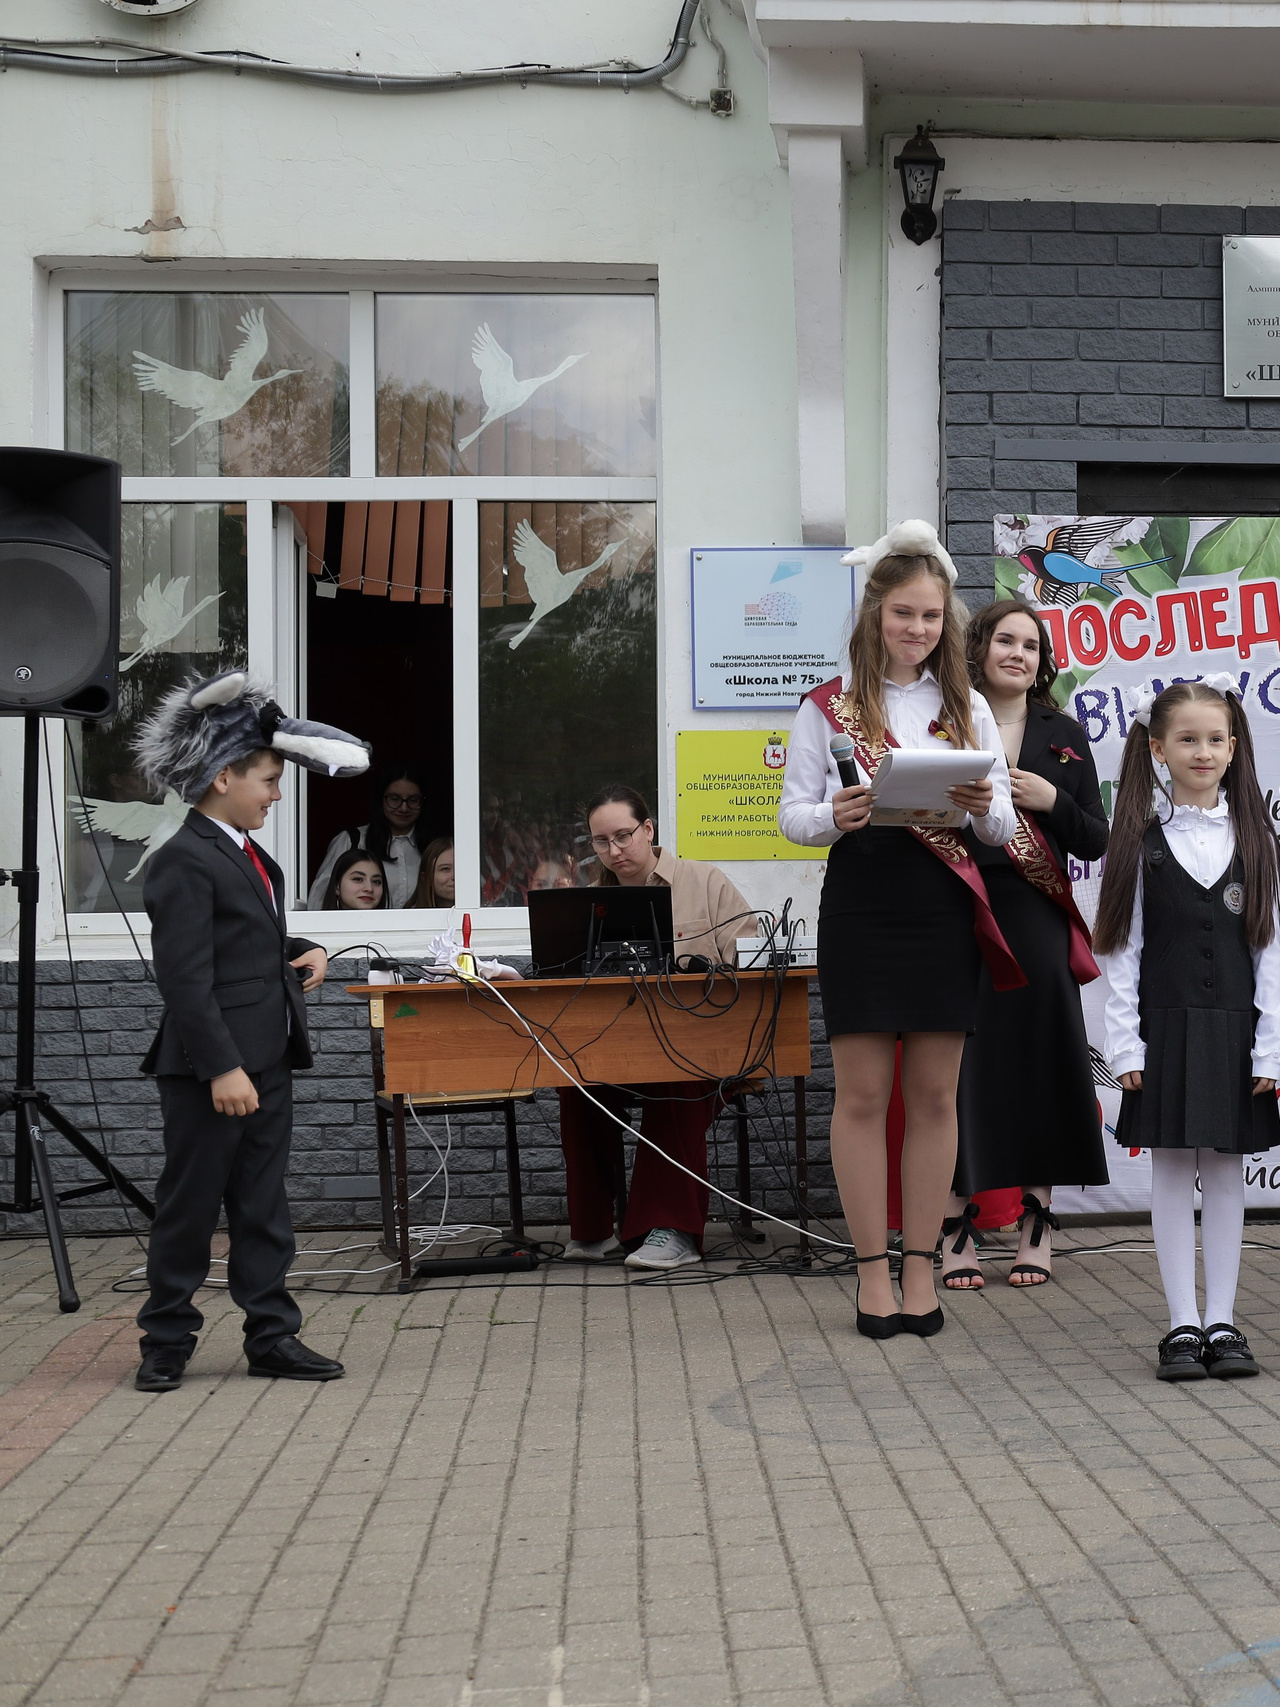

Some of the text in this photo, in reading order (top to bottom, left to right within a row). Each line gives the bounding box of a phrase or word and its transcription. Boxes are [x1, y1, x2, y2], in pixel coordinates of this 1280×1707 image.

[725, 674, 823, 685] «Школа № 75»
[703, 774, 785, 782] МУНИЦИПАЛЬНО
[686, 783, 784, 791] ОБЩЕОБРАЗОВАТЕЛЬ
[696, 829, 733, 837] НИЖНИЙ
[735, 830, 779, 838] НОВГОРОД,
